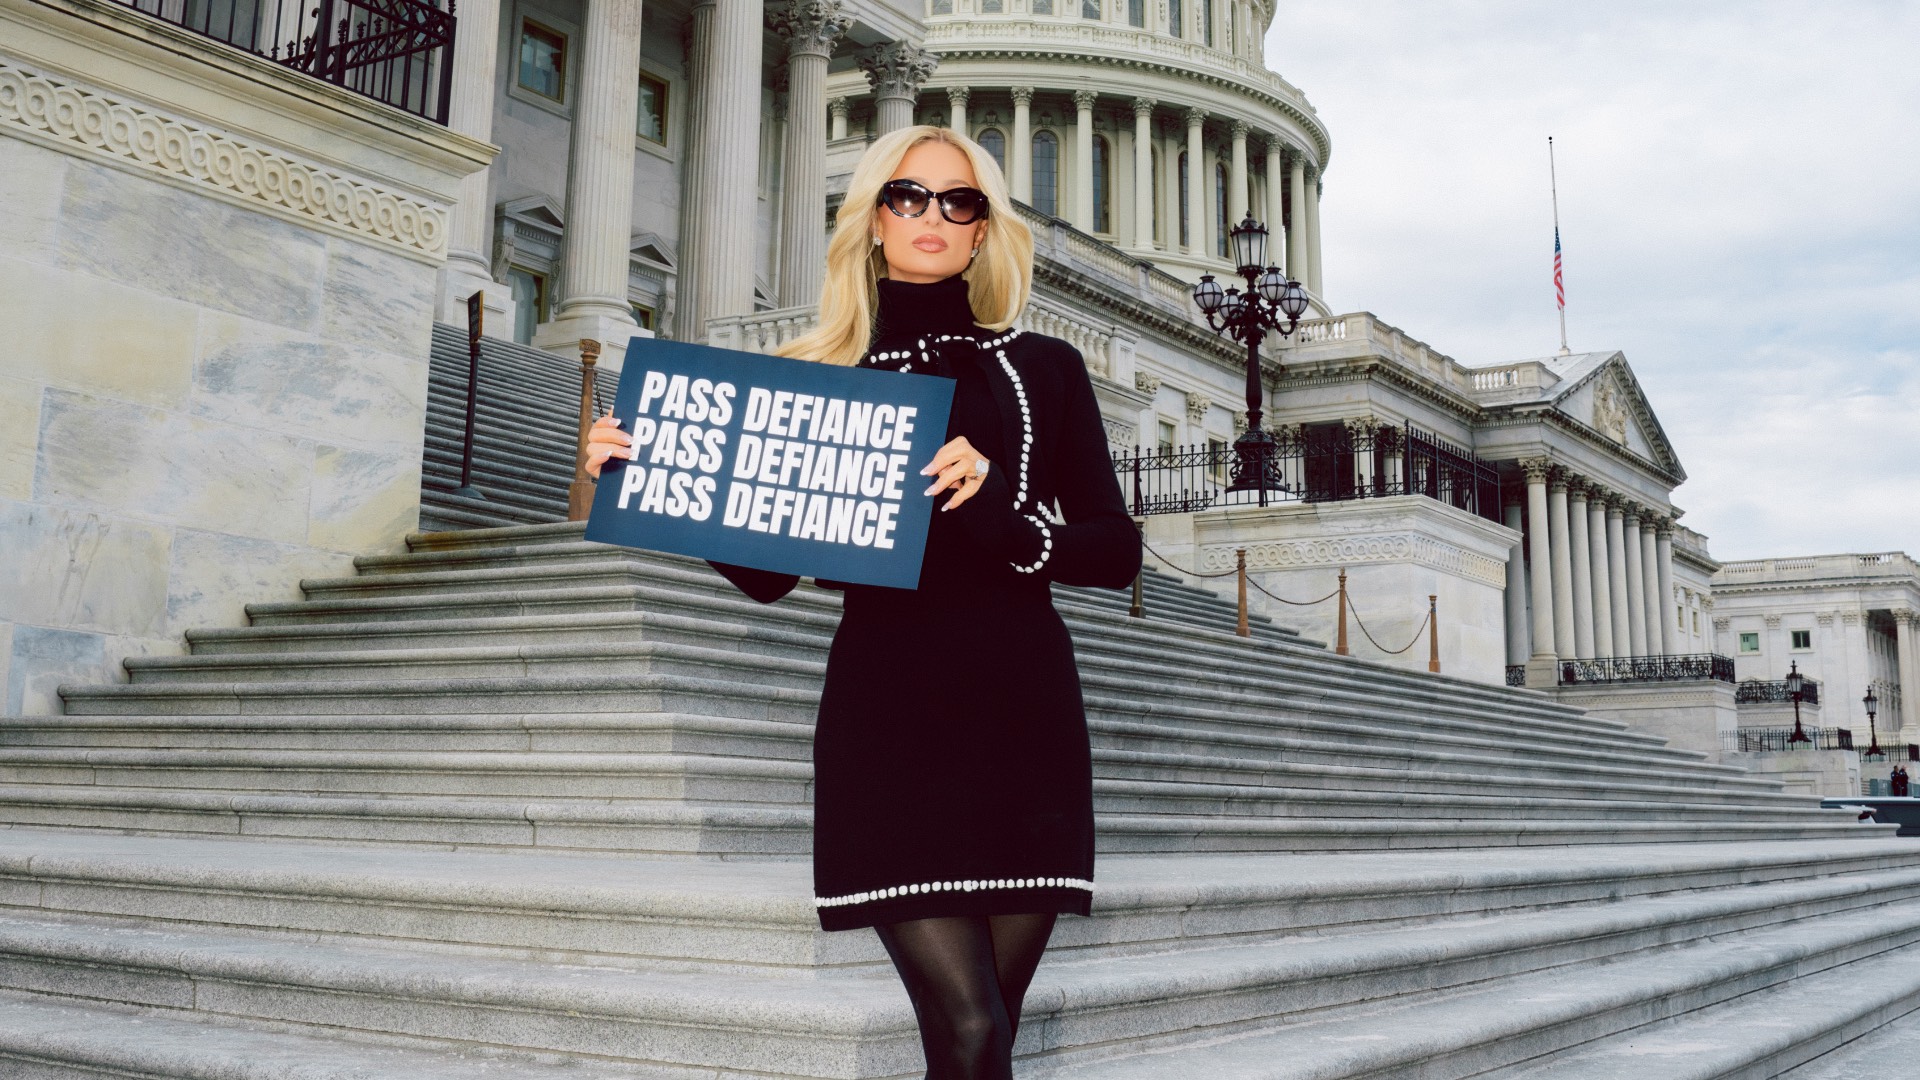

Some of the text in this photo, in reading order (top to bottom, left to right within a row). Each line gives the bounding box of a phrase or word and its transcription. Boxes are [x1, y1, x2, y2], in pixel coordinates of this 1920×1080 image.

[638, 370, 918, 451] PASS DEFIANCE
[628, 416, 909, 500] PASS DEFIANCE
[617, 464, 901, 549] PASS DEFIANCE
